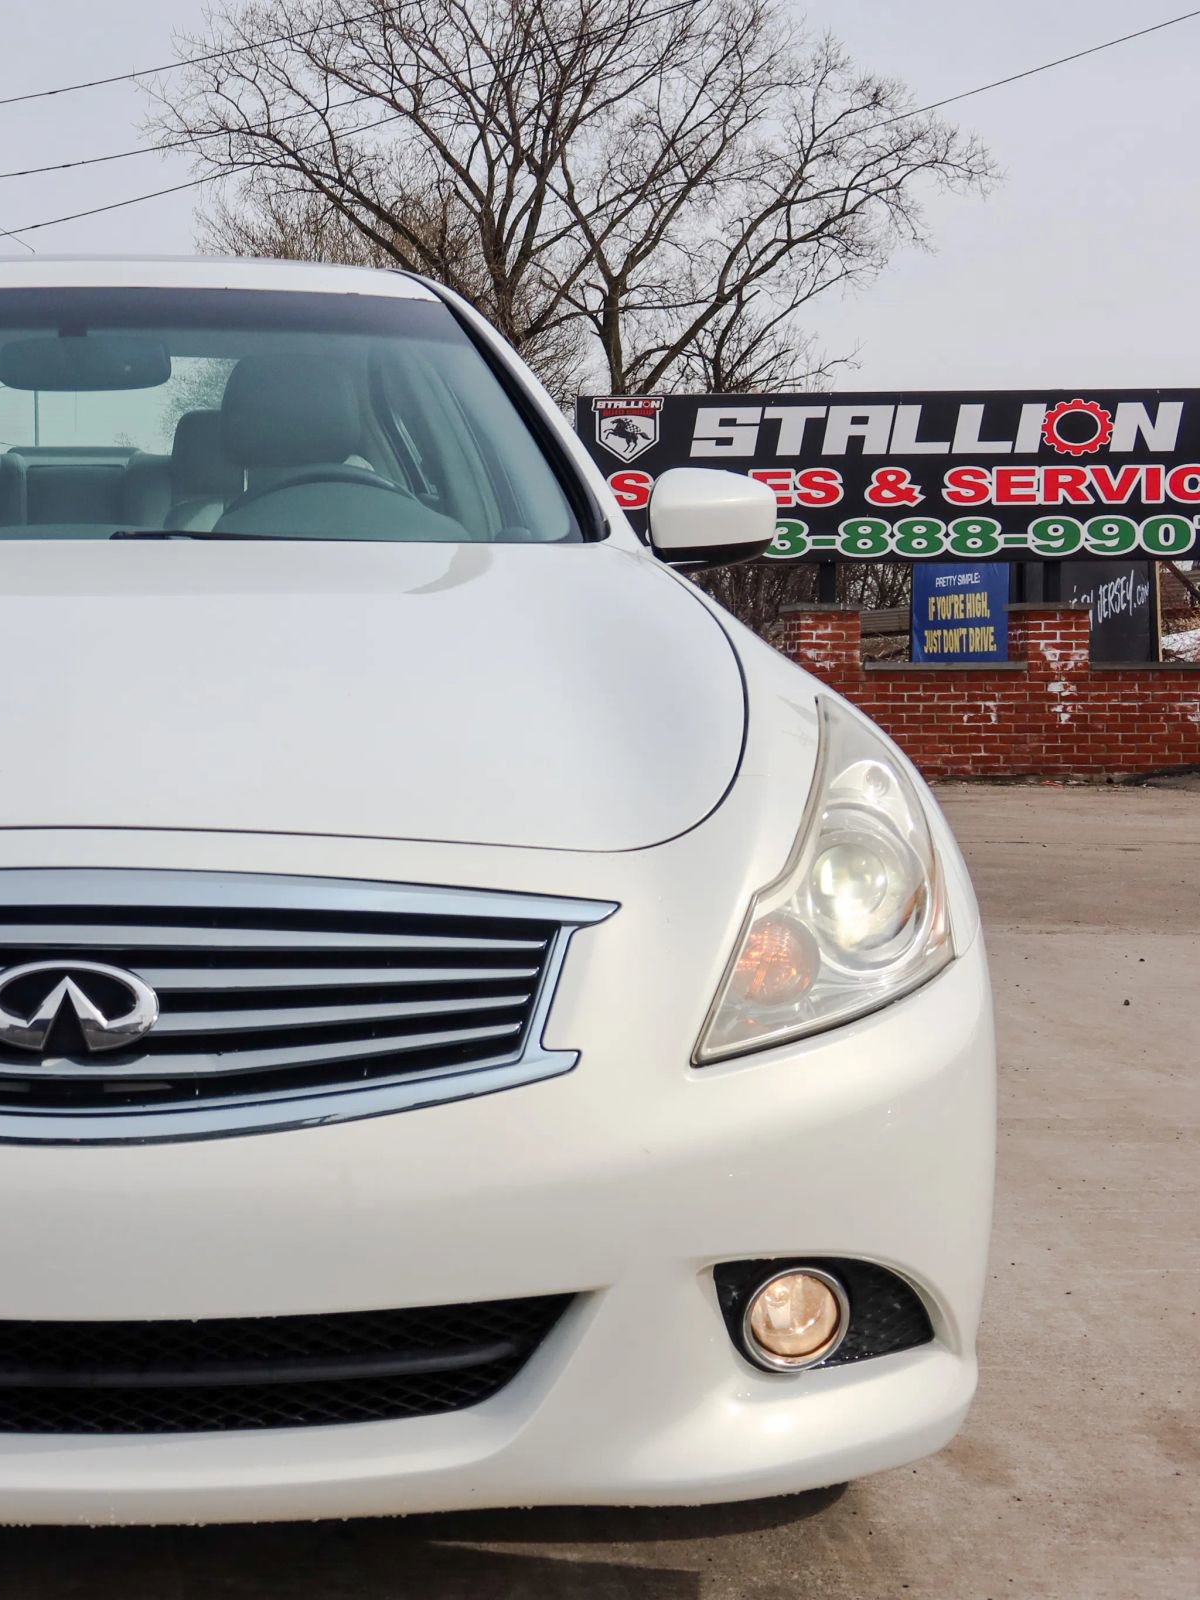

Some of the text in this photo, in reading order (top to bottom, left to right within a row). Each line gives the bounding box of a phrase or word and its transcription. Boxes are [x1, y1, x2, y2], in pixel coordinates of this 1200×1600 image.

[596, 400, 660, 409] STALLION
[689, 399, 1184, 457] STALLION
[606, 466, 844, 510] SES
[864, 466, 926, 508] &
[935, 574, 957, 588] PRETTY
[928, 591, 991, 621] IF YOU'RE HIGH,
[923, 626, 997, 654] JUST DON'T DRIVE.
